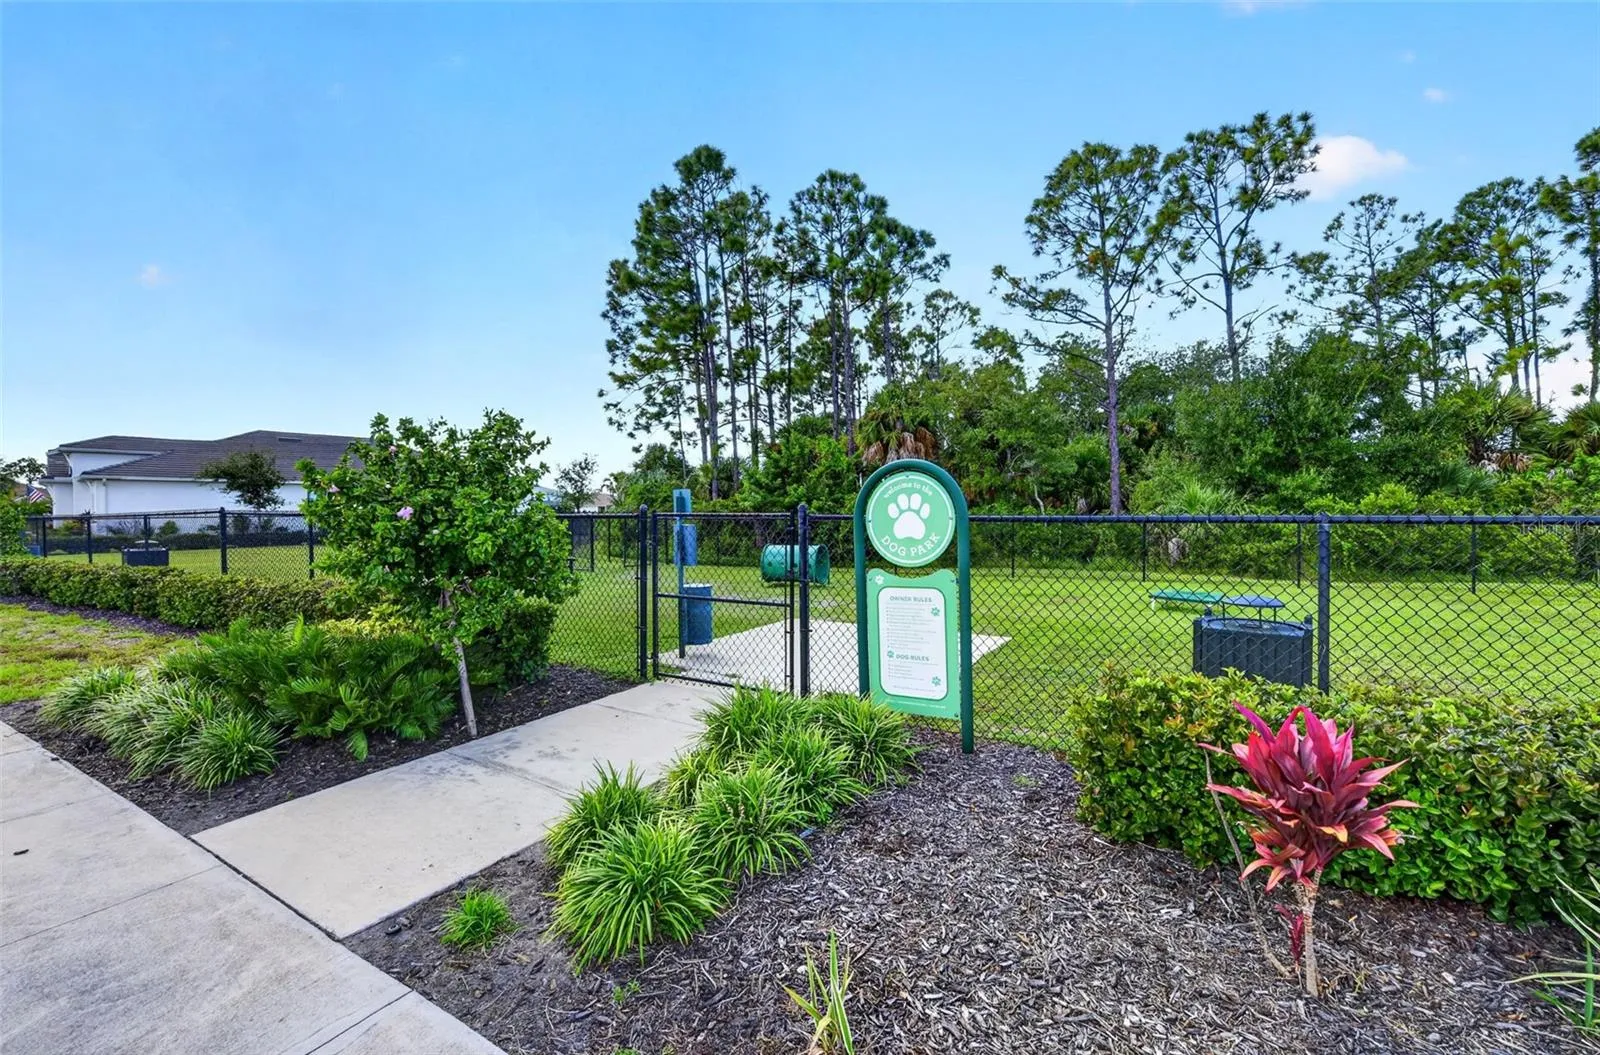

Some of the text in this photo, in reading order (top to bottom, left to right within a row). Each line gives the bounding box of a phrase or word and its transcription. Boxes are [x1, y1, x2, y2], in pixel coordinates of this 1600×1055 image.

[884, 482, 912, 498] welcome
[922, 484, 933, 496] the
[882, 533, 940, 556] DOG PARK
